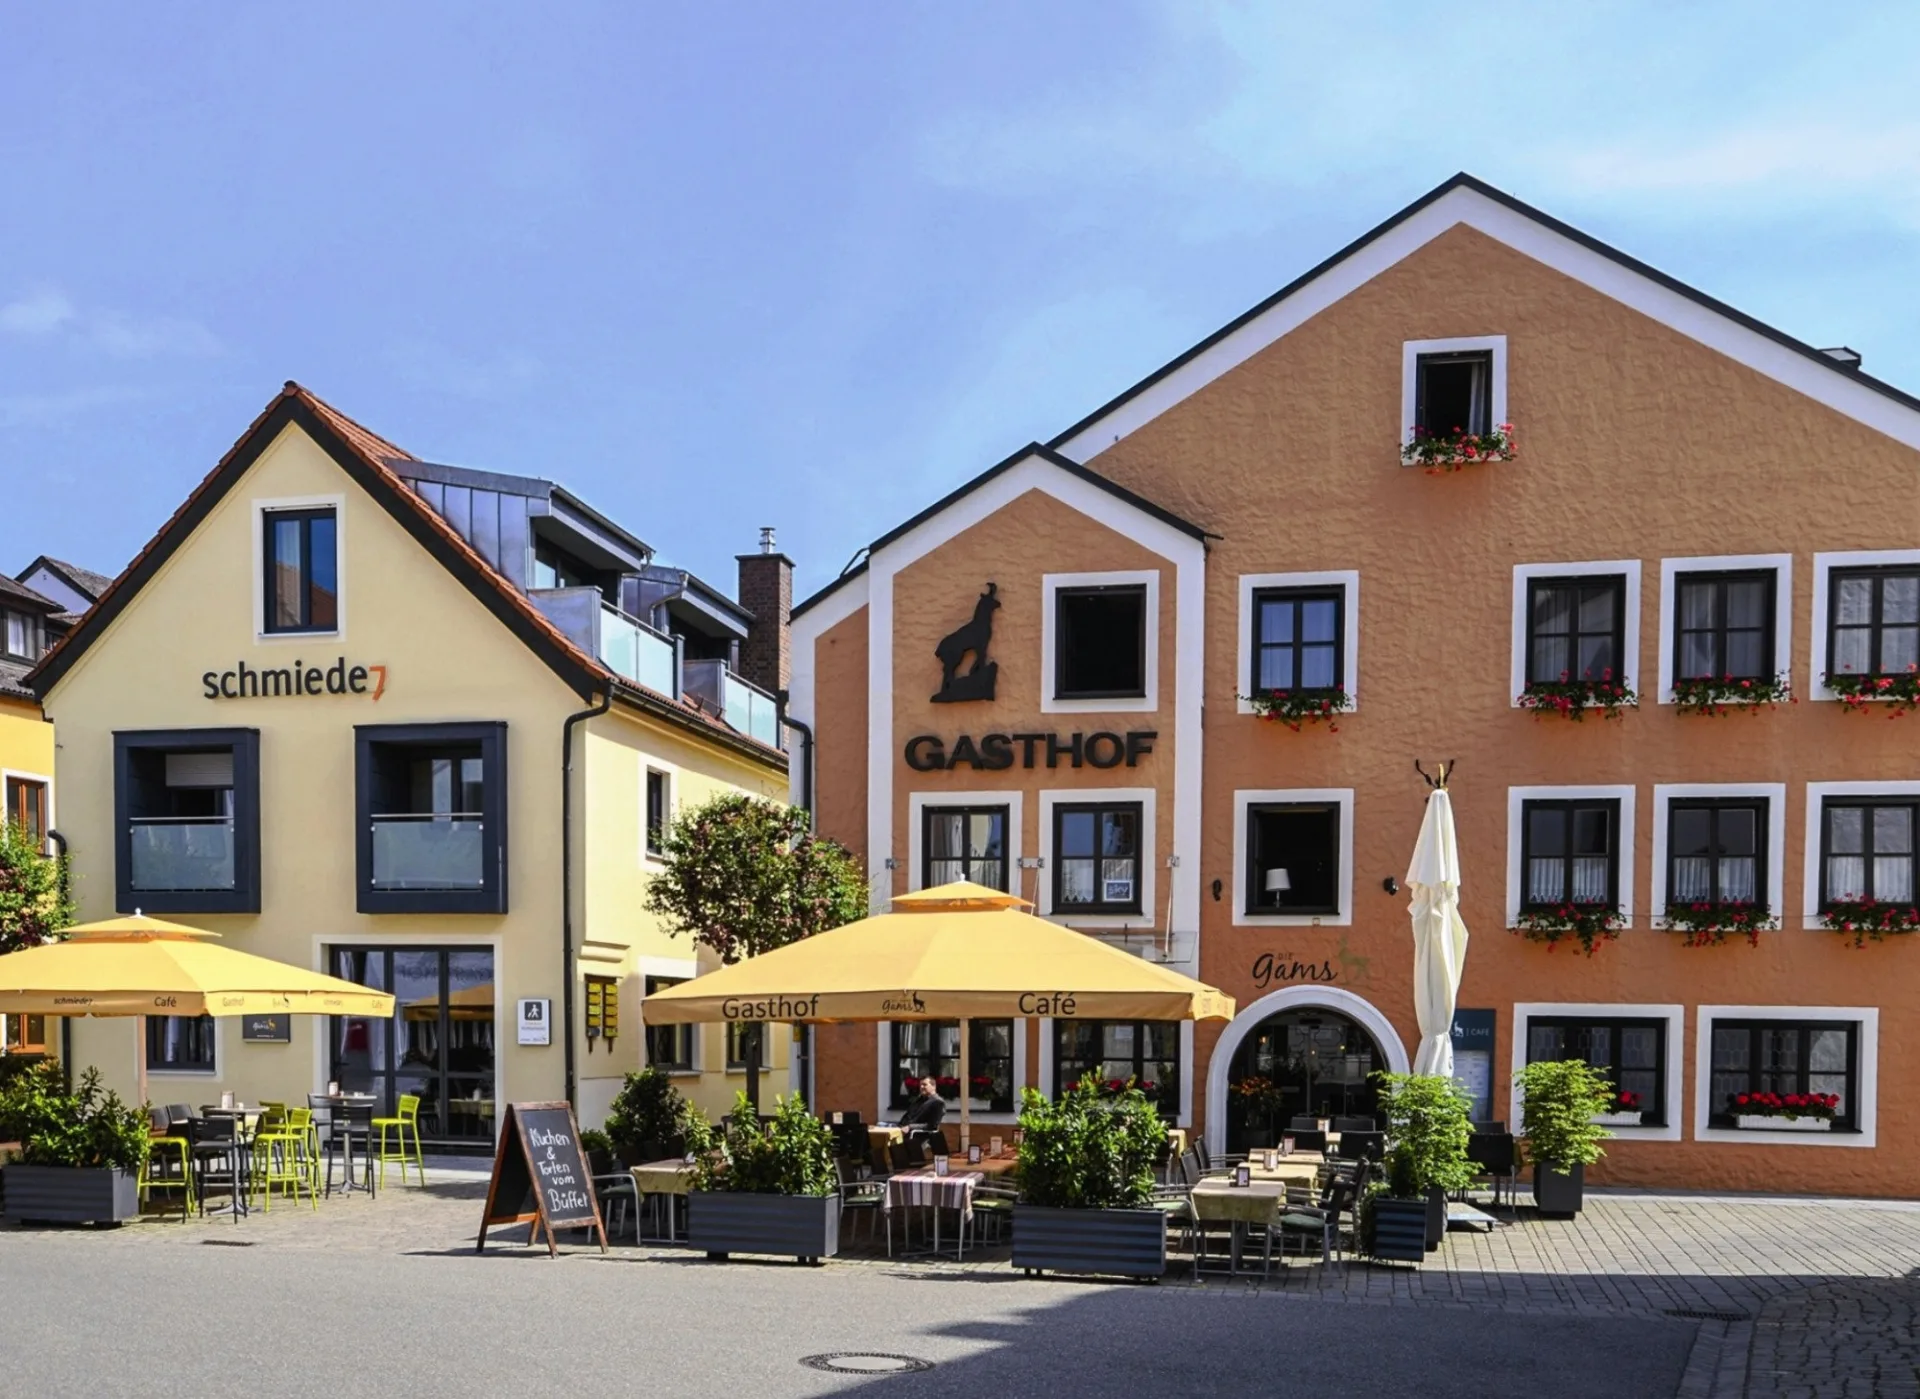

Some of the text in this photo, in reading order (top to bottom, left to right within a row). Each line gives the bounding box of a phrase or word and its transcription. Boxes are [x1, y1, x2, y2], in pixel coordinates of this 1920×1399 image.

[202, 656, 387, 703] schmiede7
[904, 731, 1158, 772] GASTHOF
[154, 996, 177, 1007] Café
[722, 993, 820, 1019] Gasthof
[1018, 991, 1076, 1016] Café
[529, 1127, 570, 1147] Kuchen
[546, 1146, 556, 1160] &
[537, 1160, 570, 1175] Torten
[551, 1175, 575, 1186] vom
